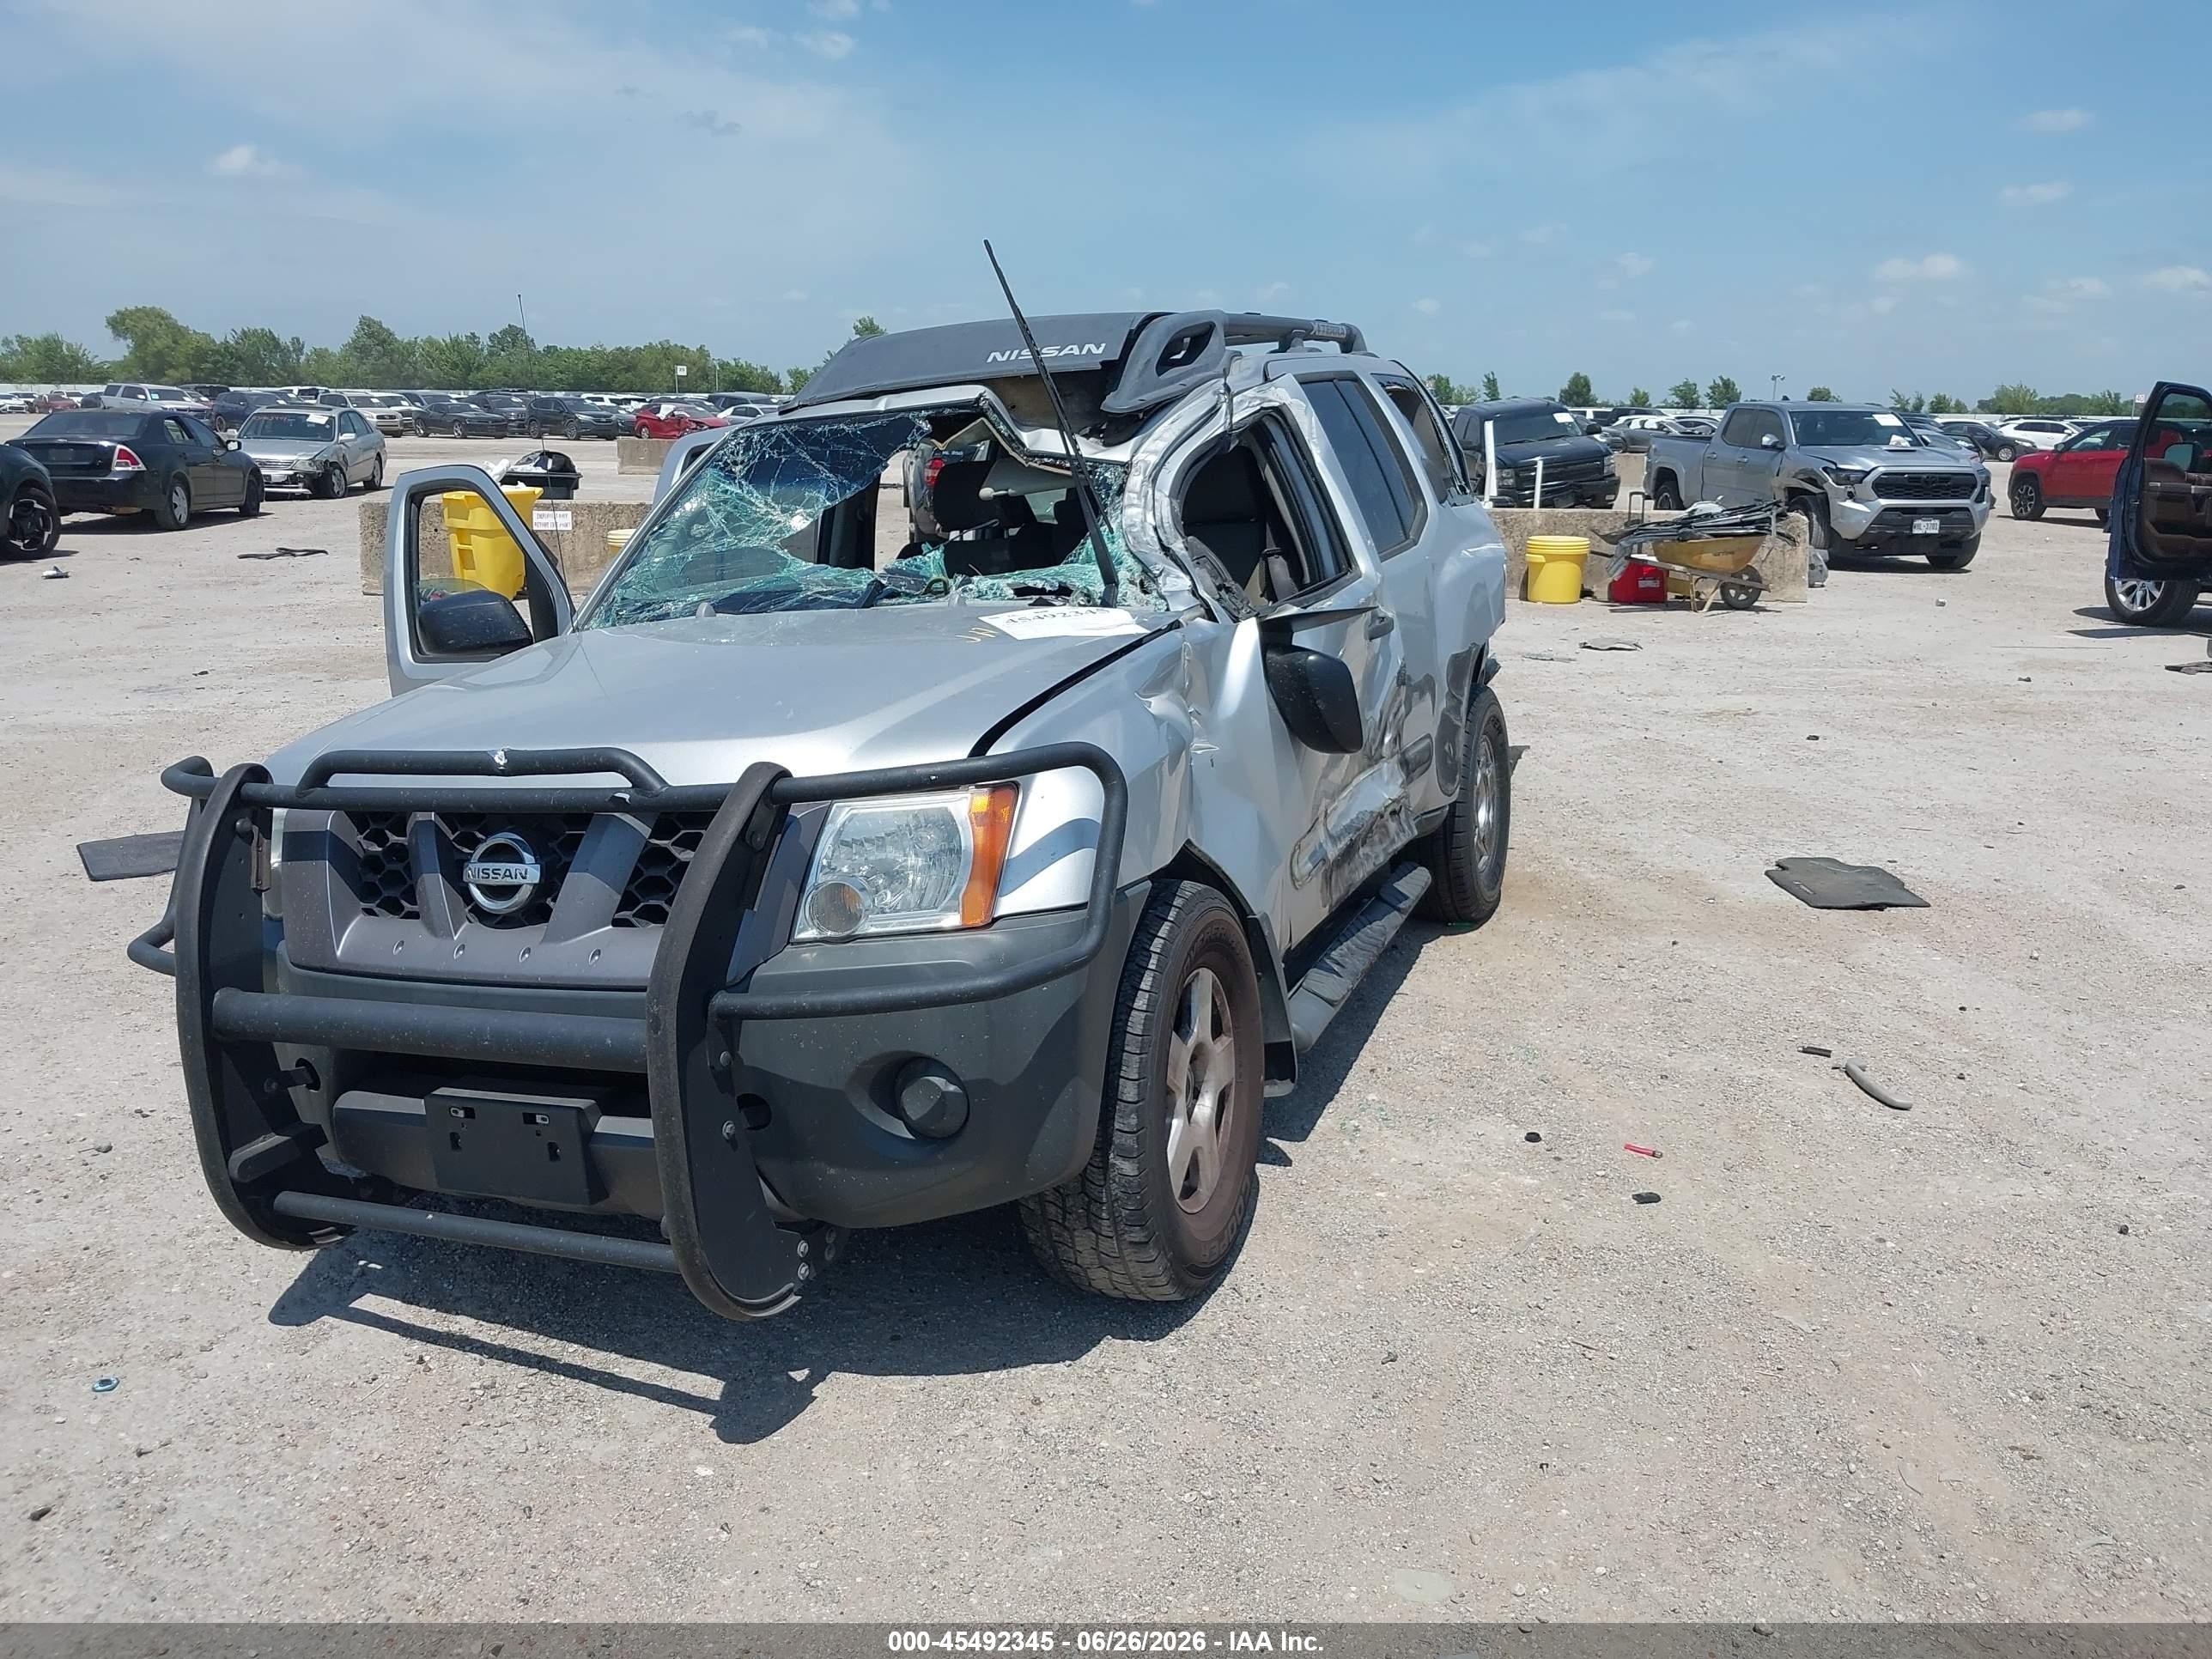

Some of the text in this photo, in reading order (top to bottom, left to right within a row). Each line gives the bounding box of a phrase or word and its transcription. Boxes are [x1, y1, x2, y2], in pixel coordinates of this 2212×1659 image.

[986, 343, 1107, 363] NISSAN
[466, 866, 528, 880] NISSAN
[1200, 1174, 1251, 1259] COOPER
